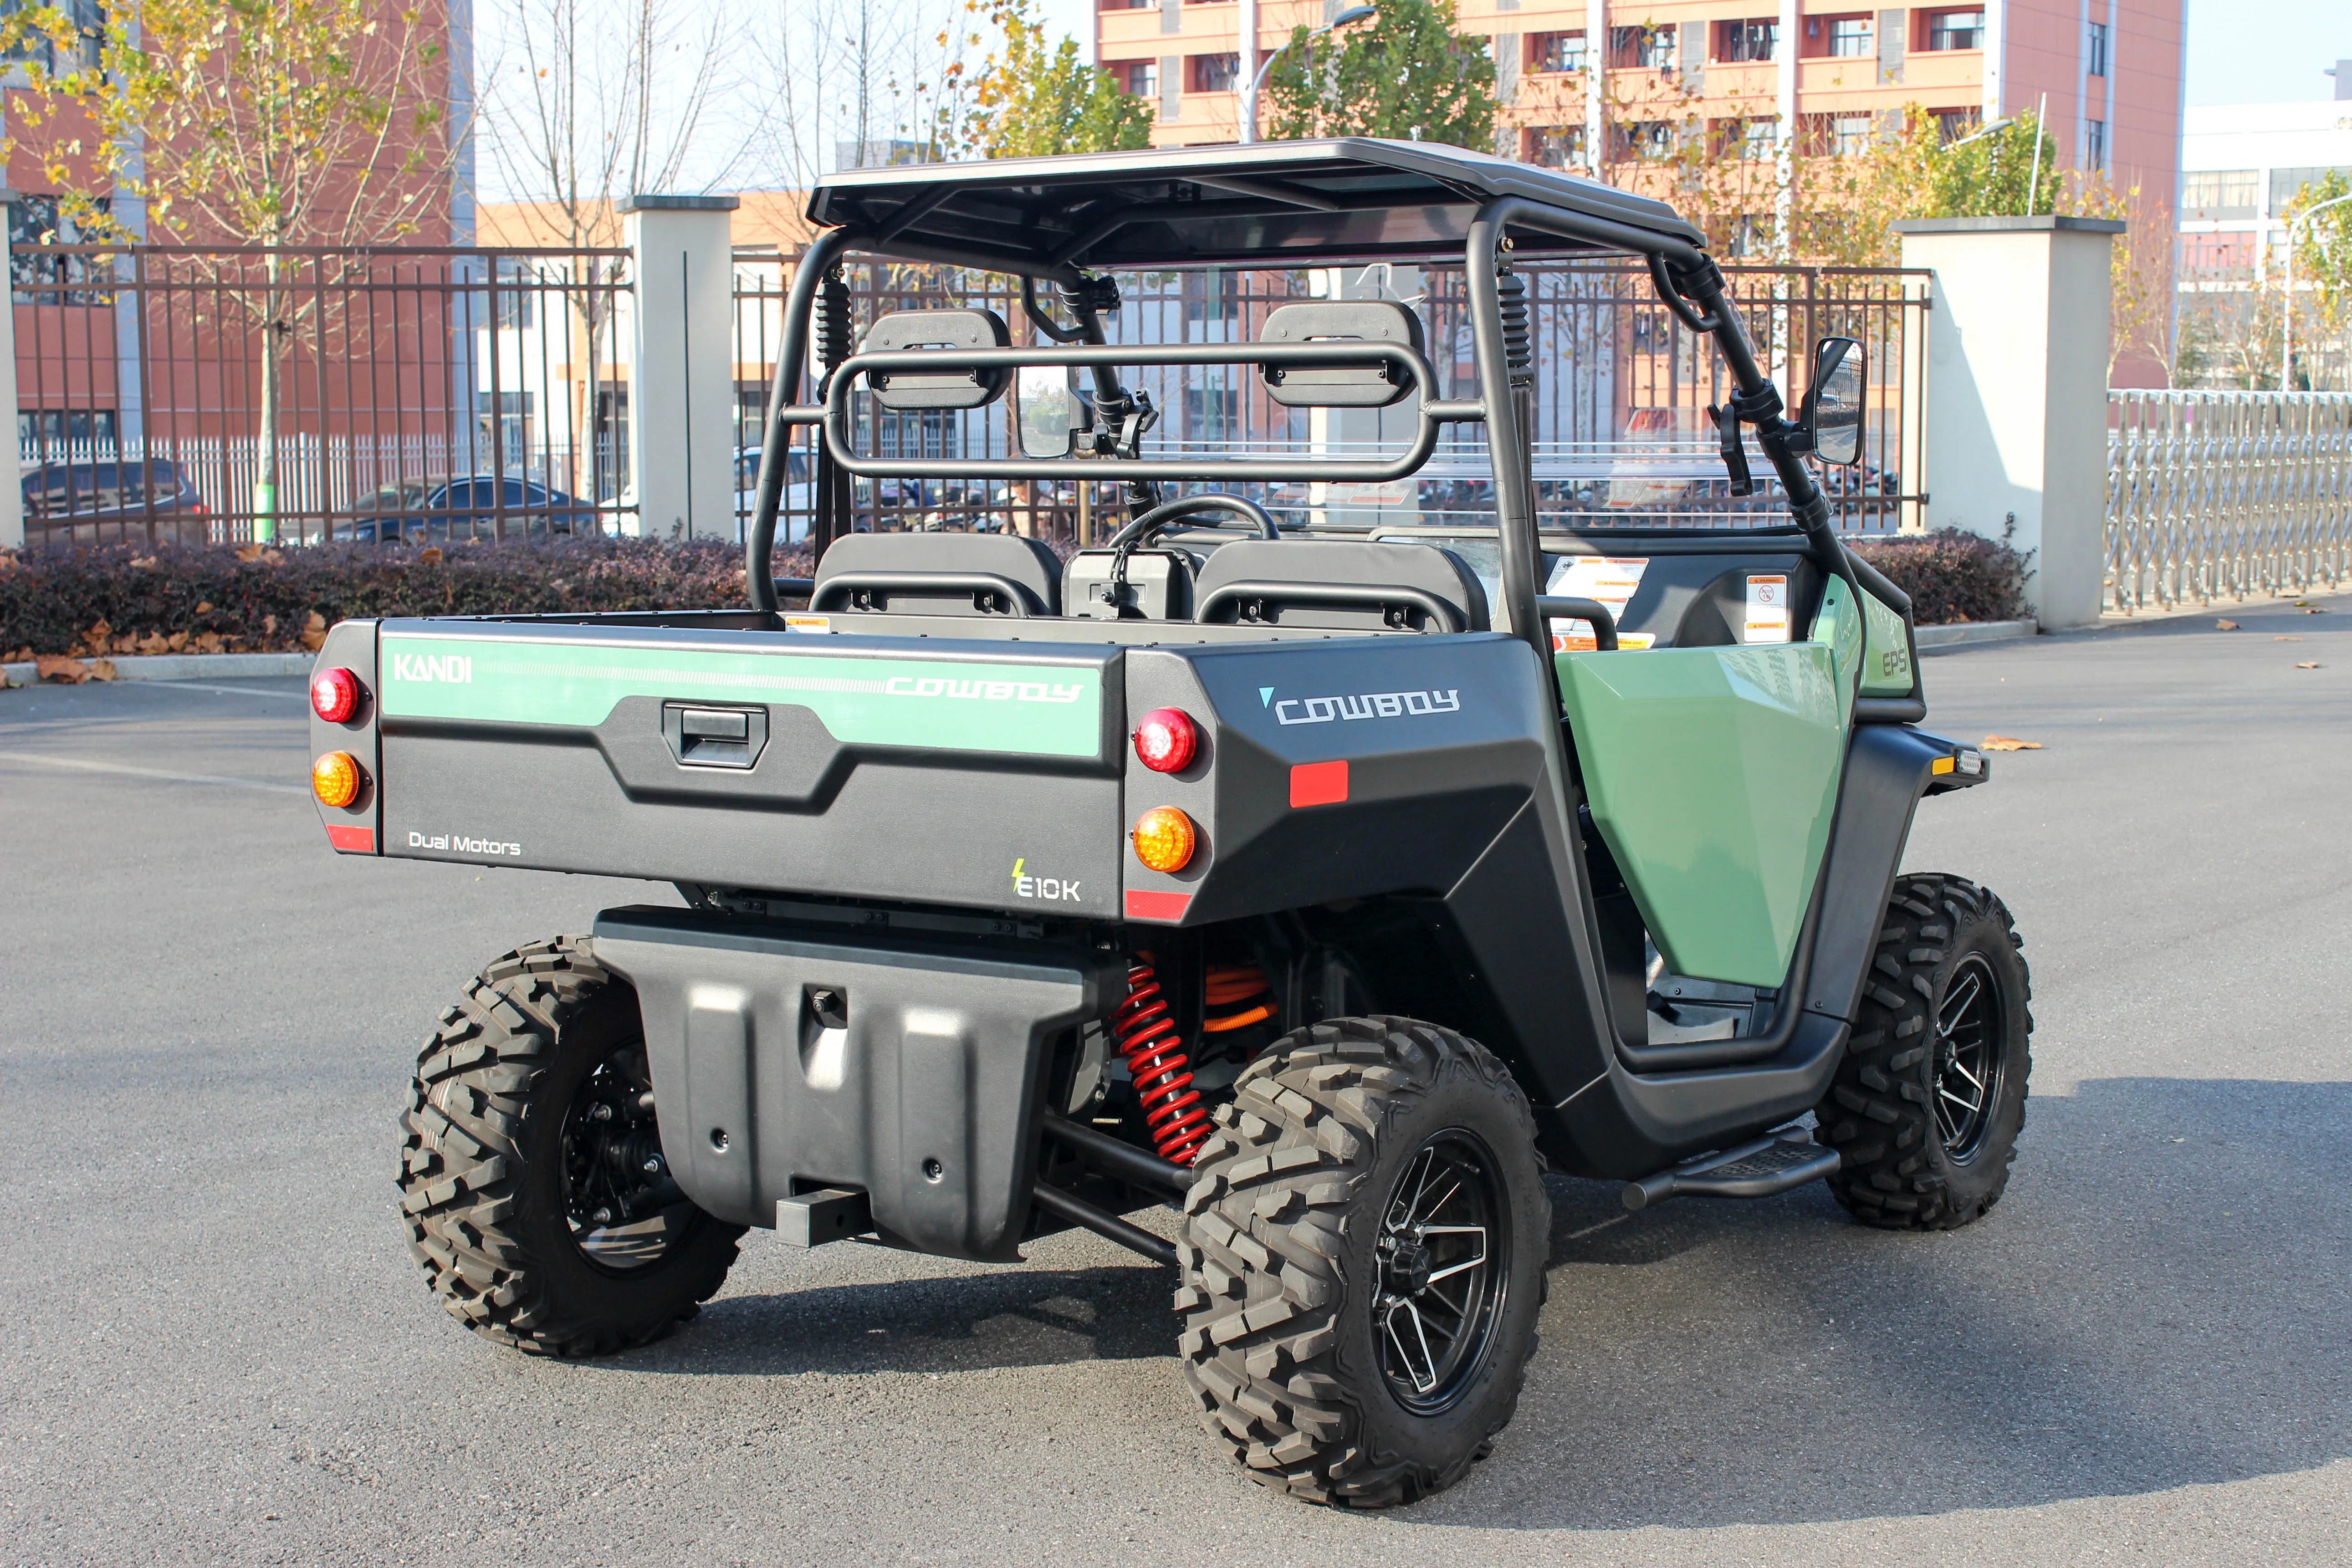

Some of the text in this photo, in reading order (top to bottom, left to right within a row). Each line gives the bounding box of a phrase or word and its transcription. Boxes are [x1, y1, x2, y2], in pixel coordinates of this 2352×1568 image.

[394, 654, 472, 683] KANDI
[1883, 649, 1907, 677] EPS
[885, 677, 1084, 703] COWBOY
[1275, 689, 1460, 725] COWBOY
[409, 832, 521, 856] Dual Motors
[1017, 876, 1081, 902] E10K
